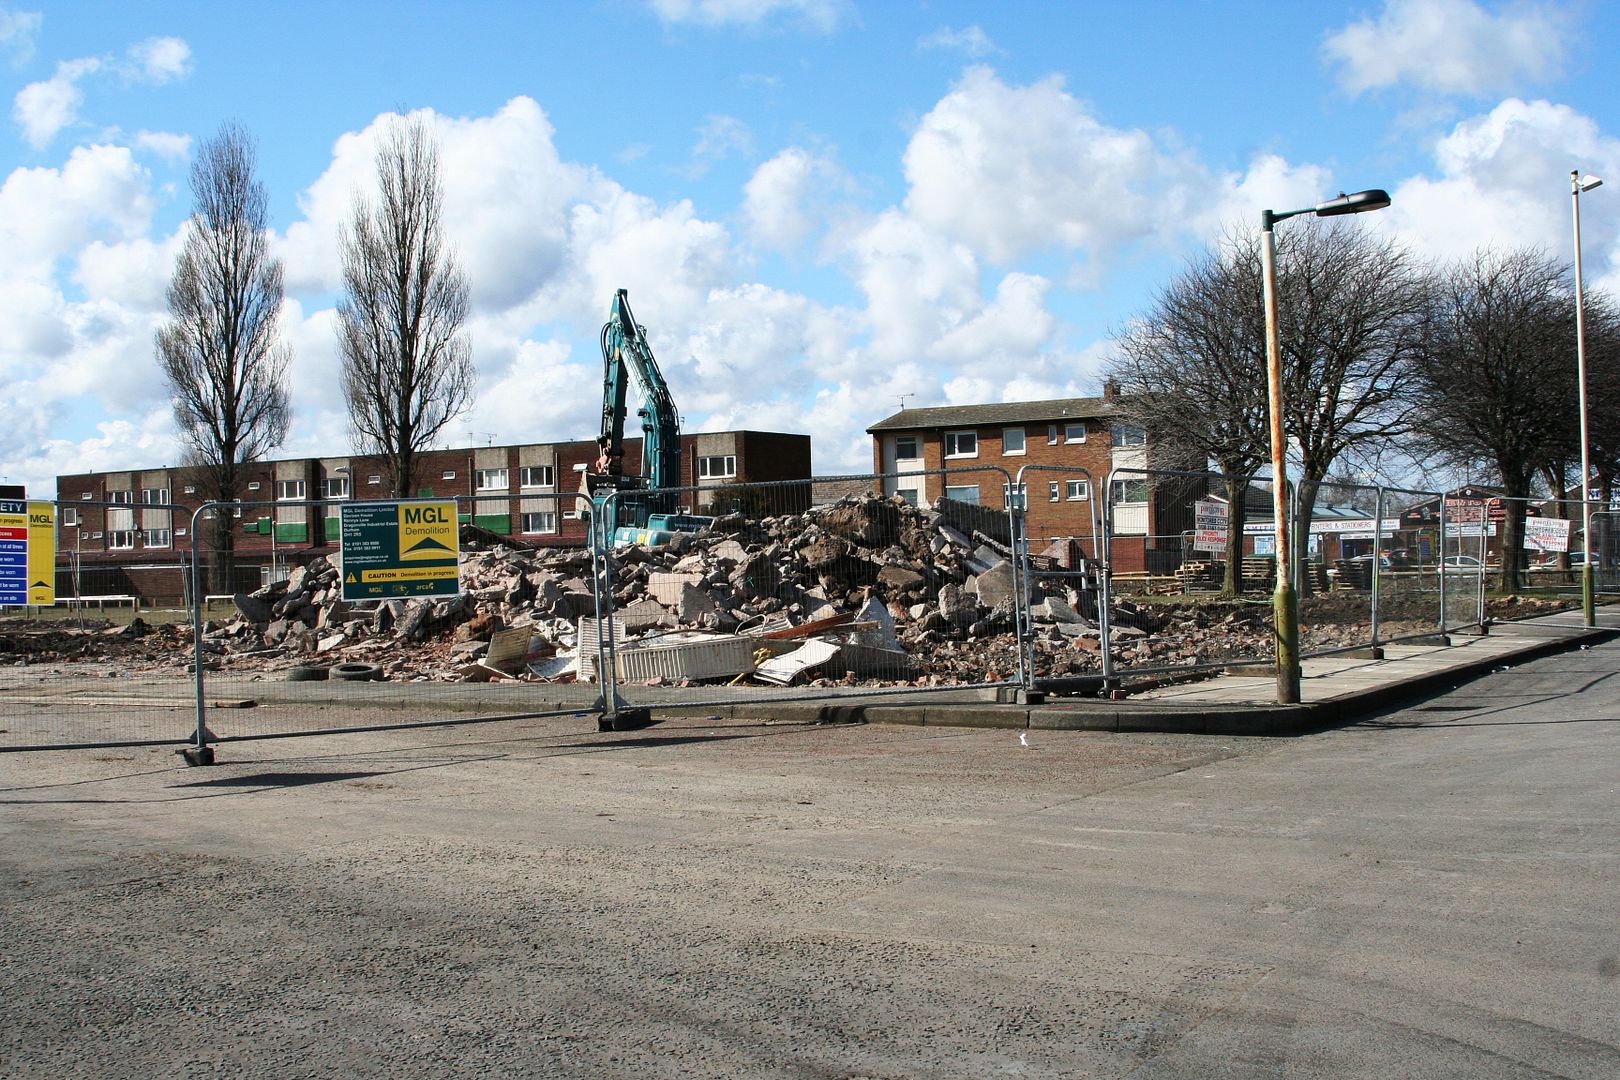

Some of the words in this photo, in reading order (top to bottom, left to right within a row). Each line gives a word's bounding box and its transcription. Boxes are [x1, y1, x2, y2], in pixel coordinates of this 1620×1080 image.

[0, 503, 22, 511] ETY
[30, 515, 53, 523] MGL
[405, 508, 448, 524] MGL
[406, 527, 450, 535] Demolition
